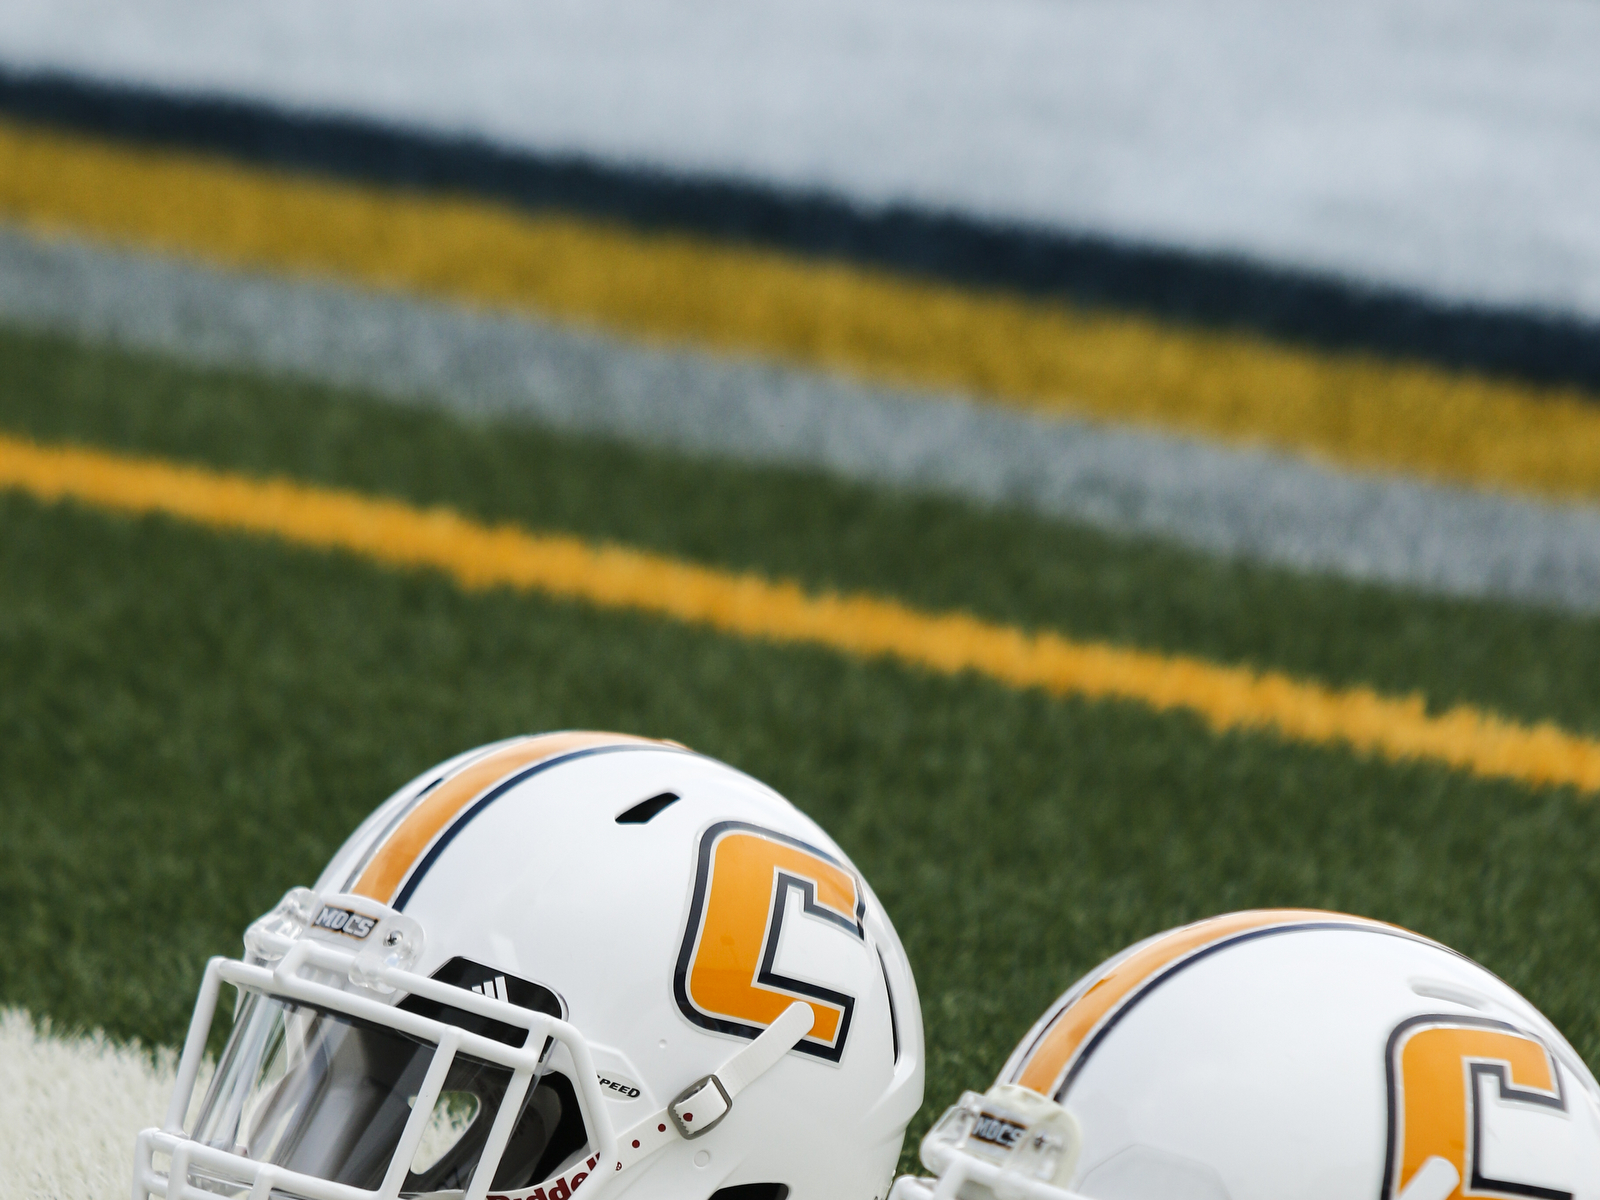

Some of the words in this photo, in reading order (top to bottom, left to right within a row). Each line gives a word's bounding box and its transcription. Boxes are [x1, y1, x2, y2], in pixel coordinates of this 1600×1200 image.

[314, 905, 377, 938] MOCS
[673, 819, 867, 1064] C
[597, 1074, 641, 1098] PEED
